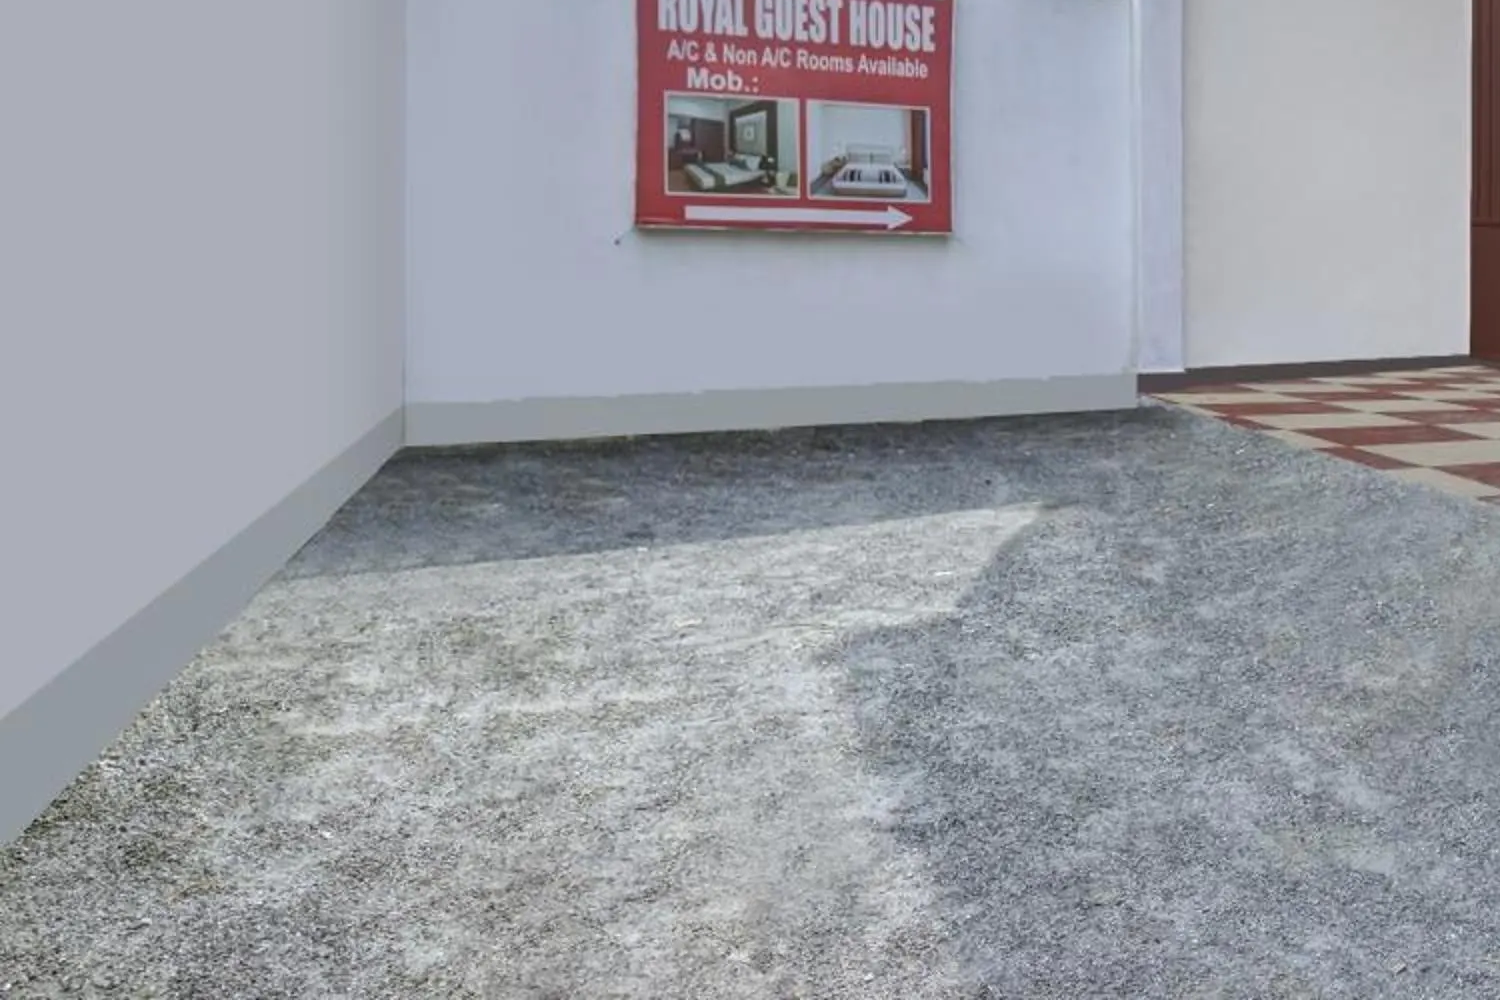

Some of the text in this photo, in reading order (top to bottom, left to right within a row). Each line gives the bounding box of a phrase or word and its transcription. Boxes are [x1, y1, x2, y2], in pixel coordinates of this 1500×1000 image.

[667, 39, 929, 79] A/C & Non A/C Rooms Available
